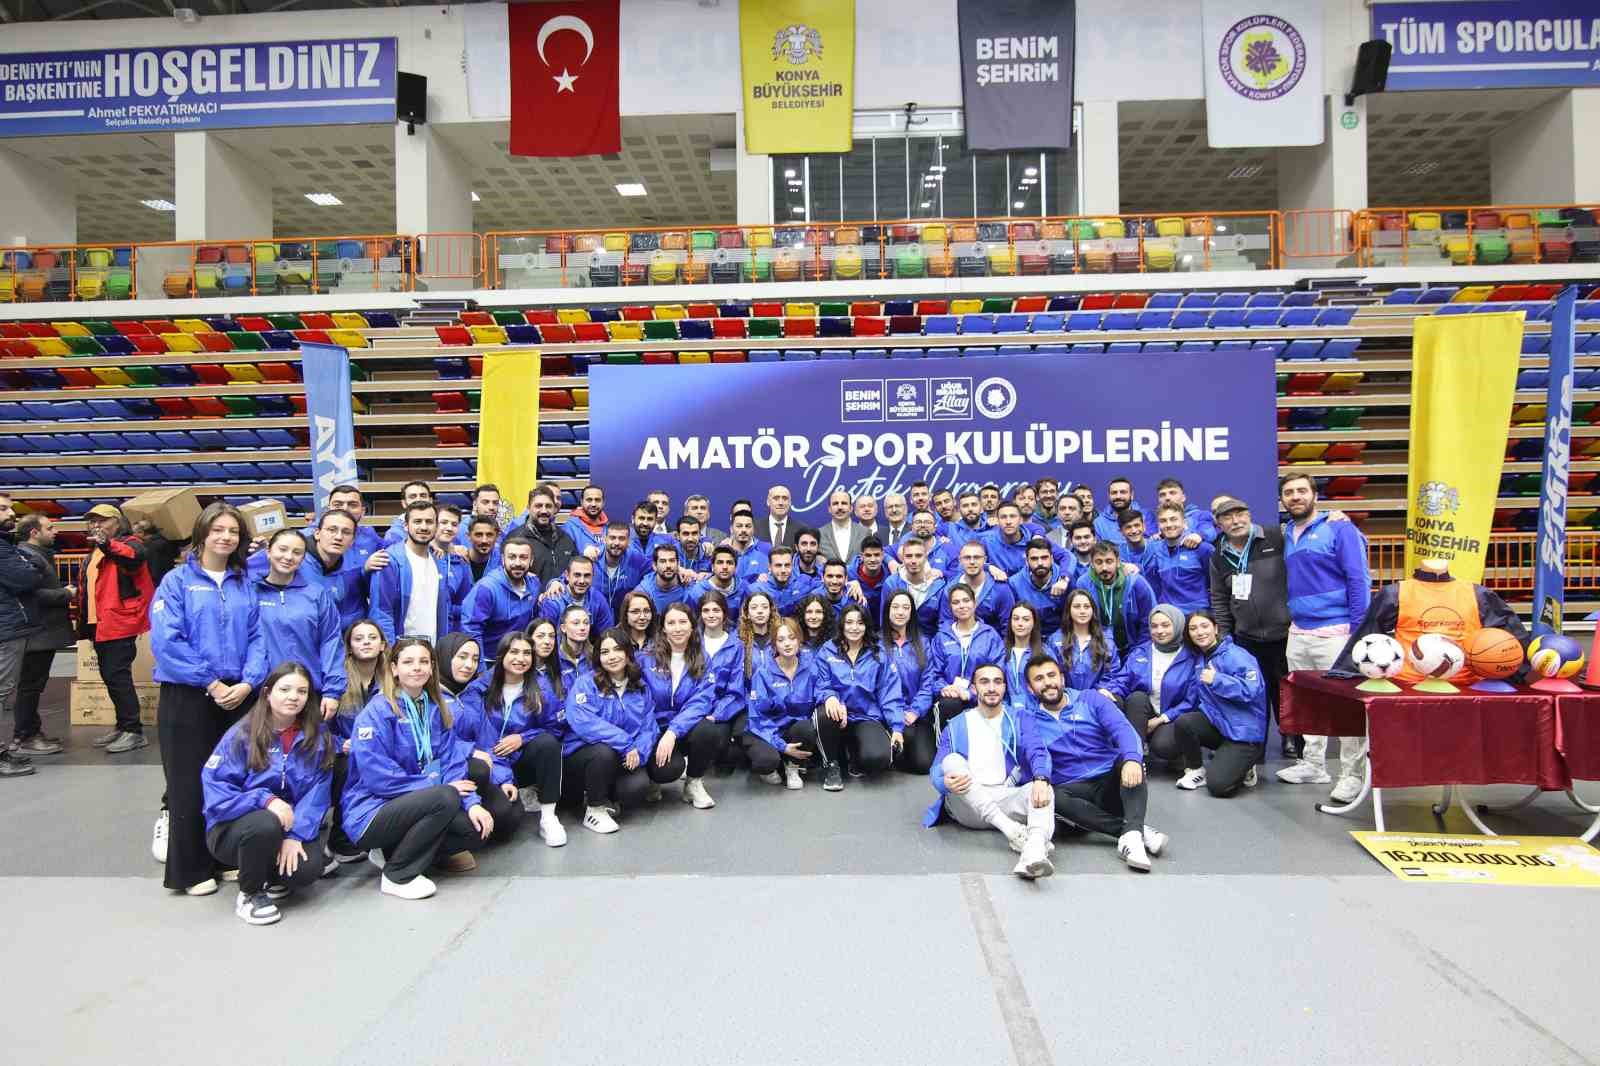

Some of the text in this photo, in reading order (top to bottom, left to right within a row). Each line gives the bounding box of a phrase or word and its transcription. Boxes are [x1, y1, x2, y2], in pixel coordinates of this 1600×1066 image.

[1381, 17, 1445, 55] TÜM
[104, 42, 381, 103] HOŞGELDİNİZ
[775, 70, 820, 81] KONYA
[88, 107, 125, 118] Ahmet
[638, 420, 1230, 470] AMATÖR SPOR KULÜPLERİNE
